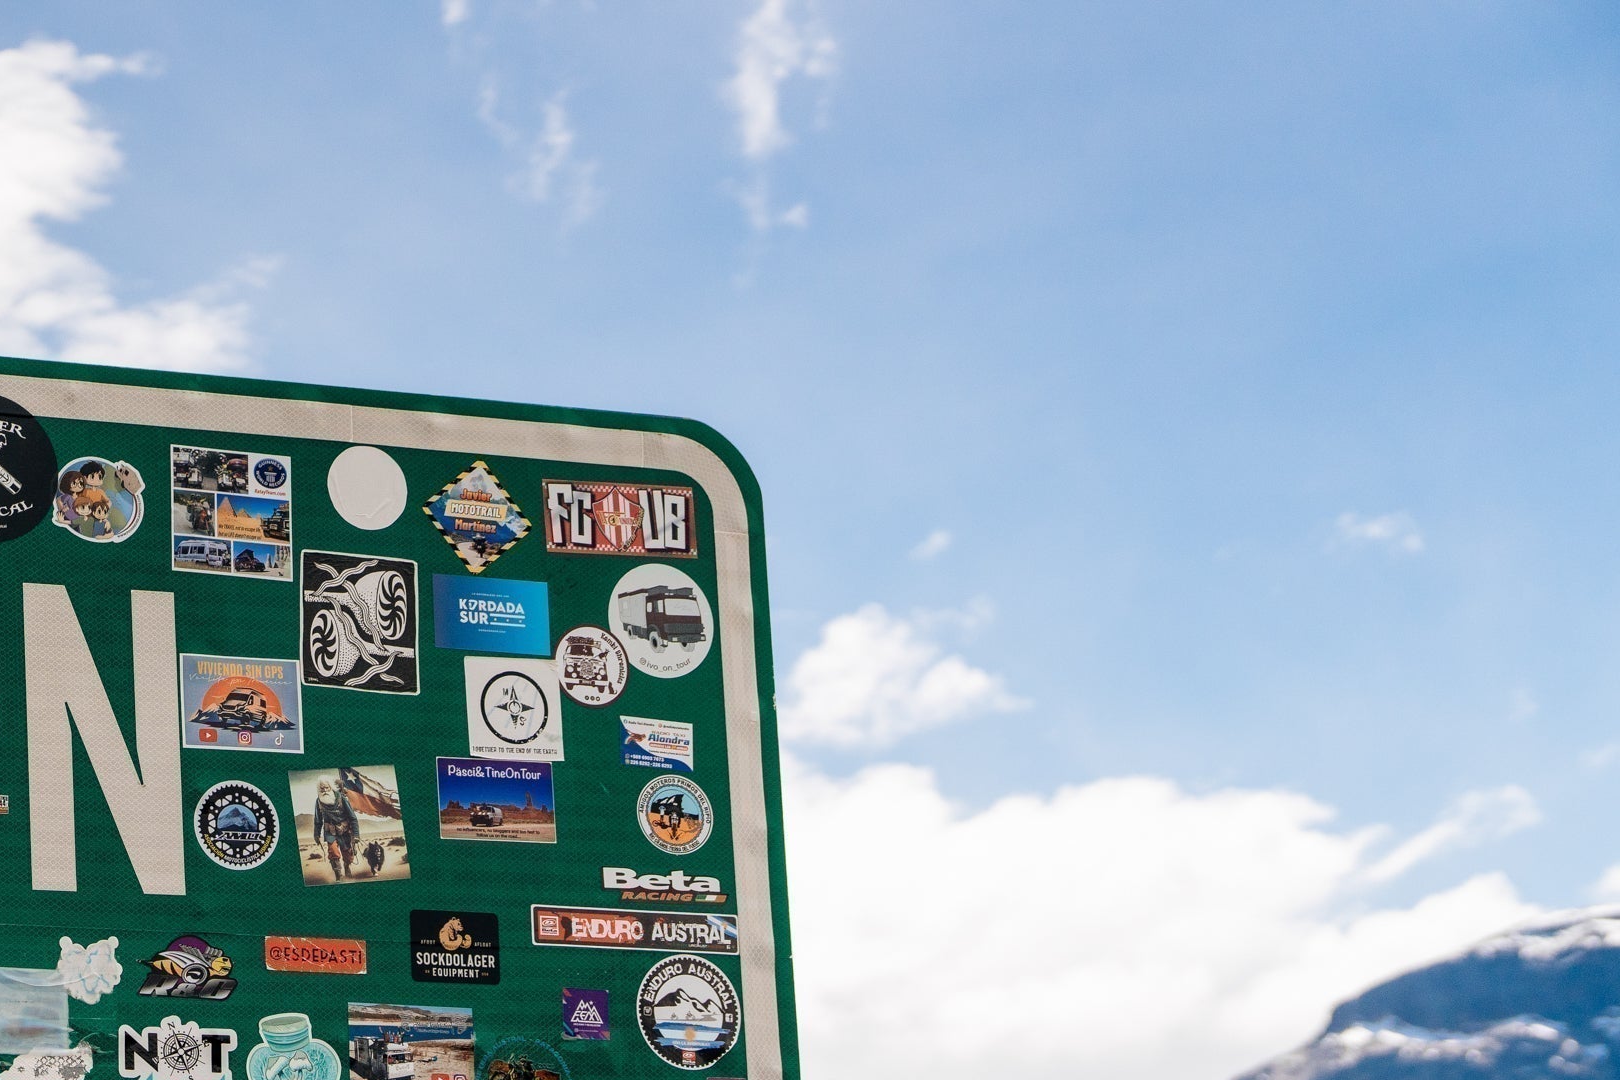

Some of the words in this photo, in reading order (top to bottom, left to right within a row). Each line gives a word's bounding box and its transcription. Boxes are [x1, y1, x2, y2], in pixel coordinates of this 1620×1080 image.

[450, 503, 502, 518] MOTOTRAIL
[460, 611, 489, 624] SUR
[197, 661, 243, 677] VIVIENDO
[245, 664, 263, 679] SIN
[265, 666, 283, 680] GPS
[648, 734, 690, 746] Alondra
[640, 790, 651, 814] AMIGOS
[650, 778, 676, 792] MOTEROS
[677, 779, 698, 794] PRIMOS
[698, 794, 706, 805] DEL
[603, 867, 720, 892] Beta
[621, 892, 693, 901] RACING
[416, 952, 495, 968] SOCKDOLAGER
[432, 967, 479, 978] EQUIPMENT
